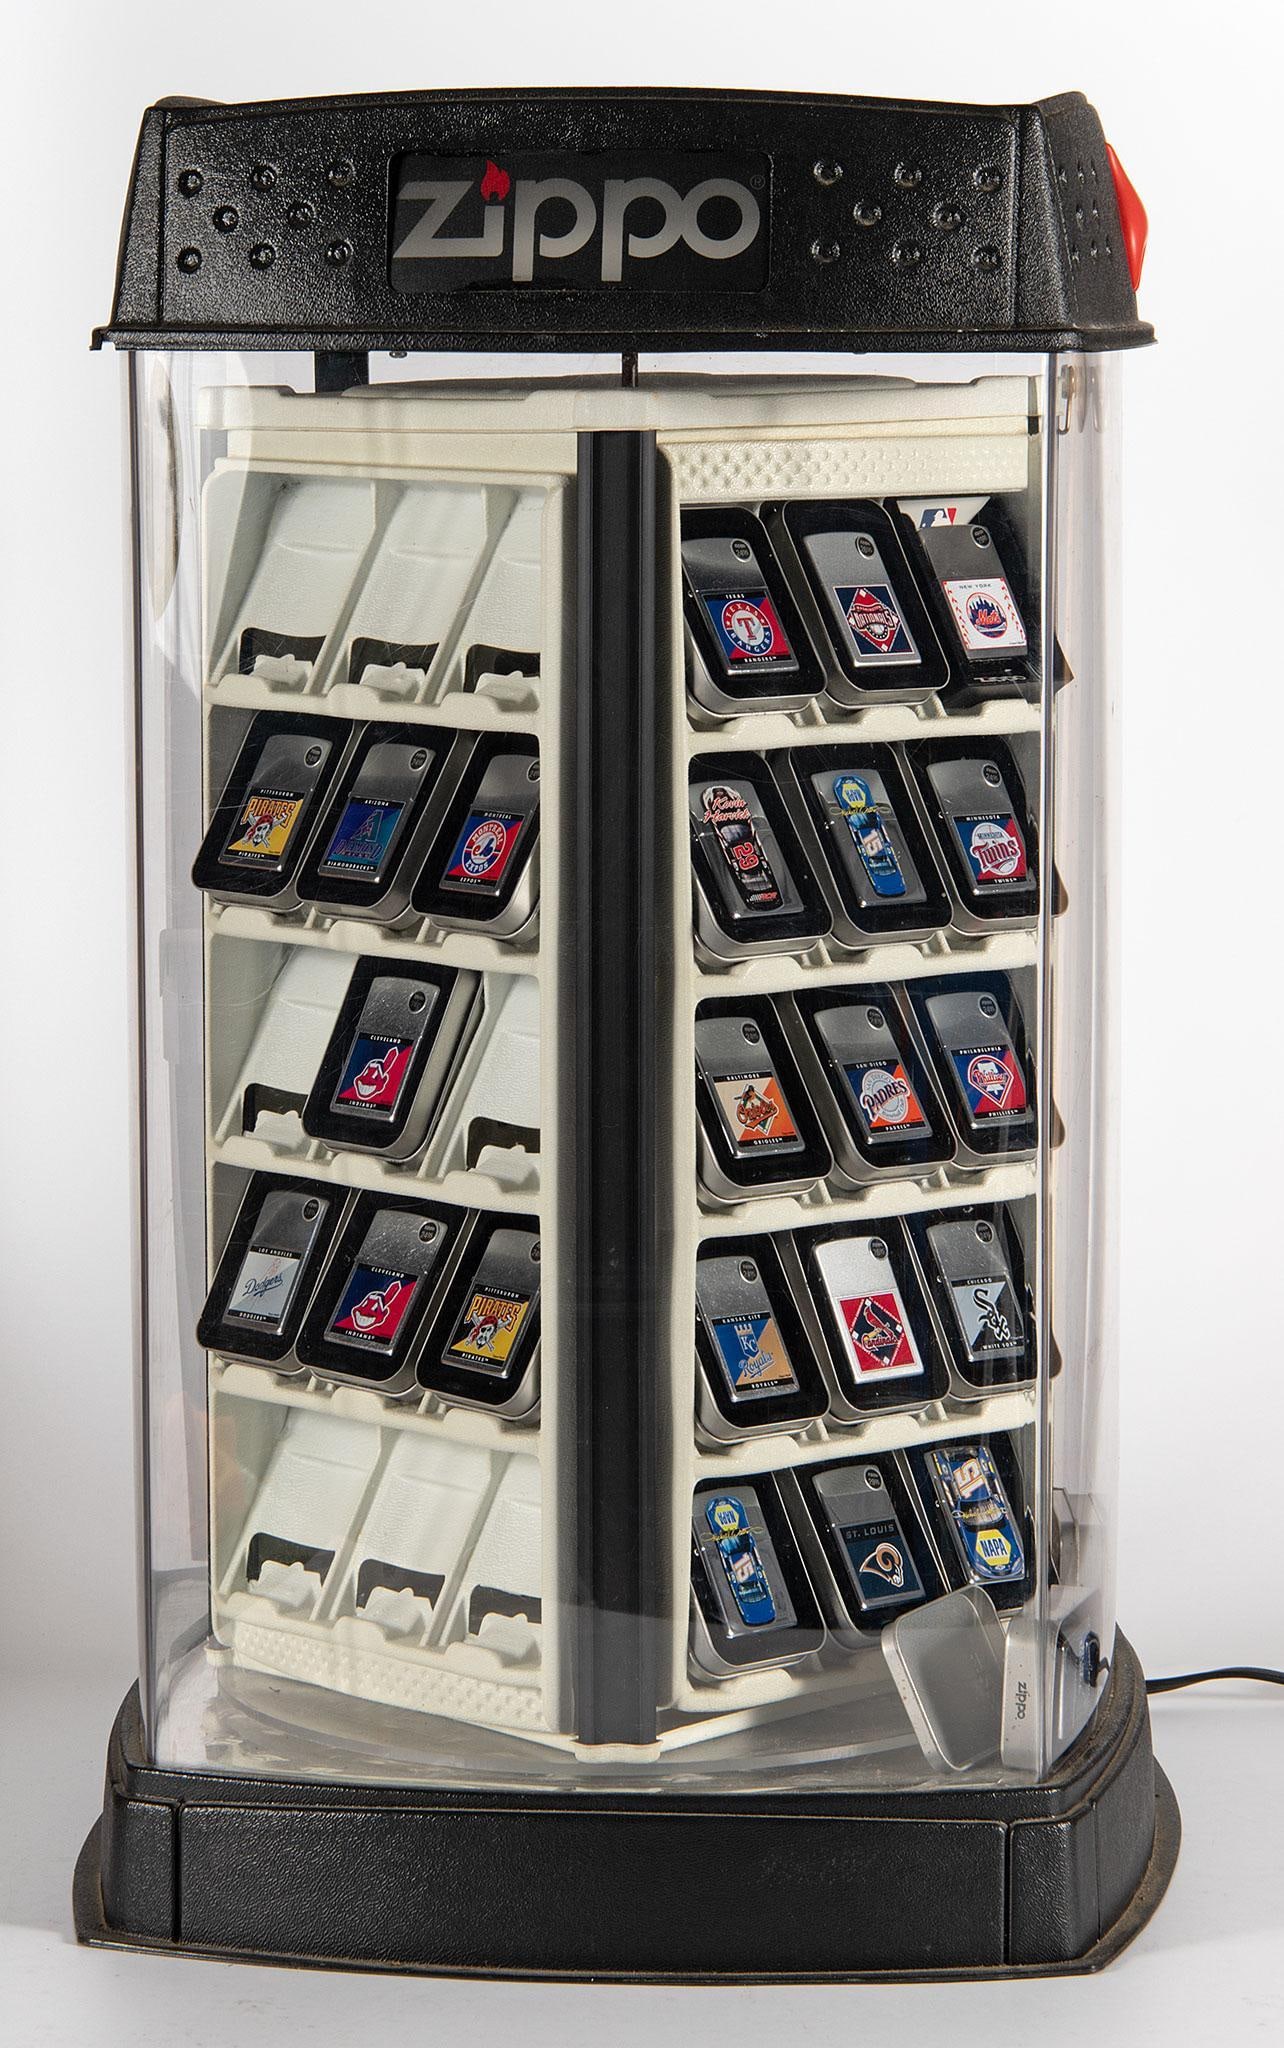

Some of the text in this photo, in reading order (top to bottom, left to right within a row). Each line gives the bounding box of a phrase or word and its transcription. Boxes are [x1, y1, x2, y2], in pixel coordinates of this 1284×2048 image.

[725, 603, 759, 619] TEXAS
[736, 617, 757, 641] T
[730, 630, 771, 653] RANGERS
[240, 796, 298, 830] PIRATES
[472, 823, 504, 846] MONTREAL
[732, 841, 760, 871] 29
[971, 838, 1019, 870] Twins
[465, 860, 489, 873] EXPOS
[862, 1080, 908, 1119] PADRES
[242, 1272, 284, 1298] Dodgers
[464, 1293, 523, 1335] PIRATES
[740, 1336, 758, 1353] KC
[845, 1523, 895, 1540] ST. LOUIS
[979, 1537, 1008, 1558] NAPA
